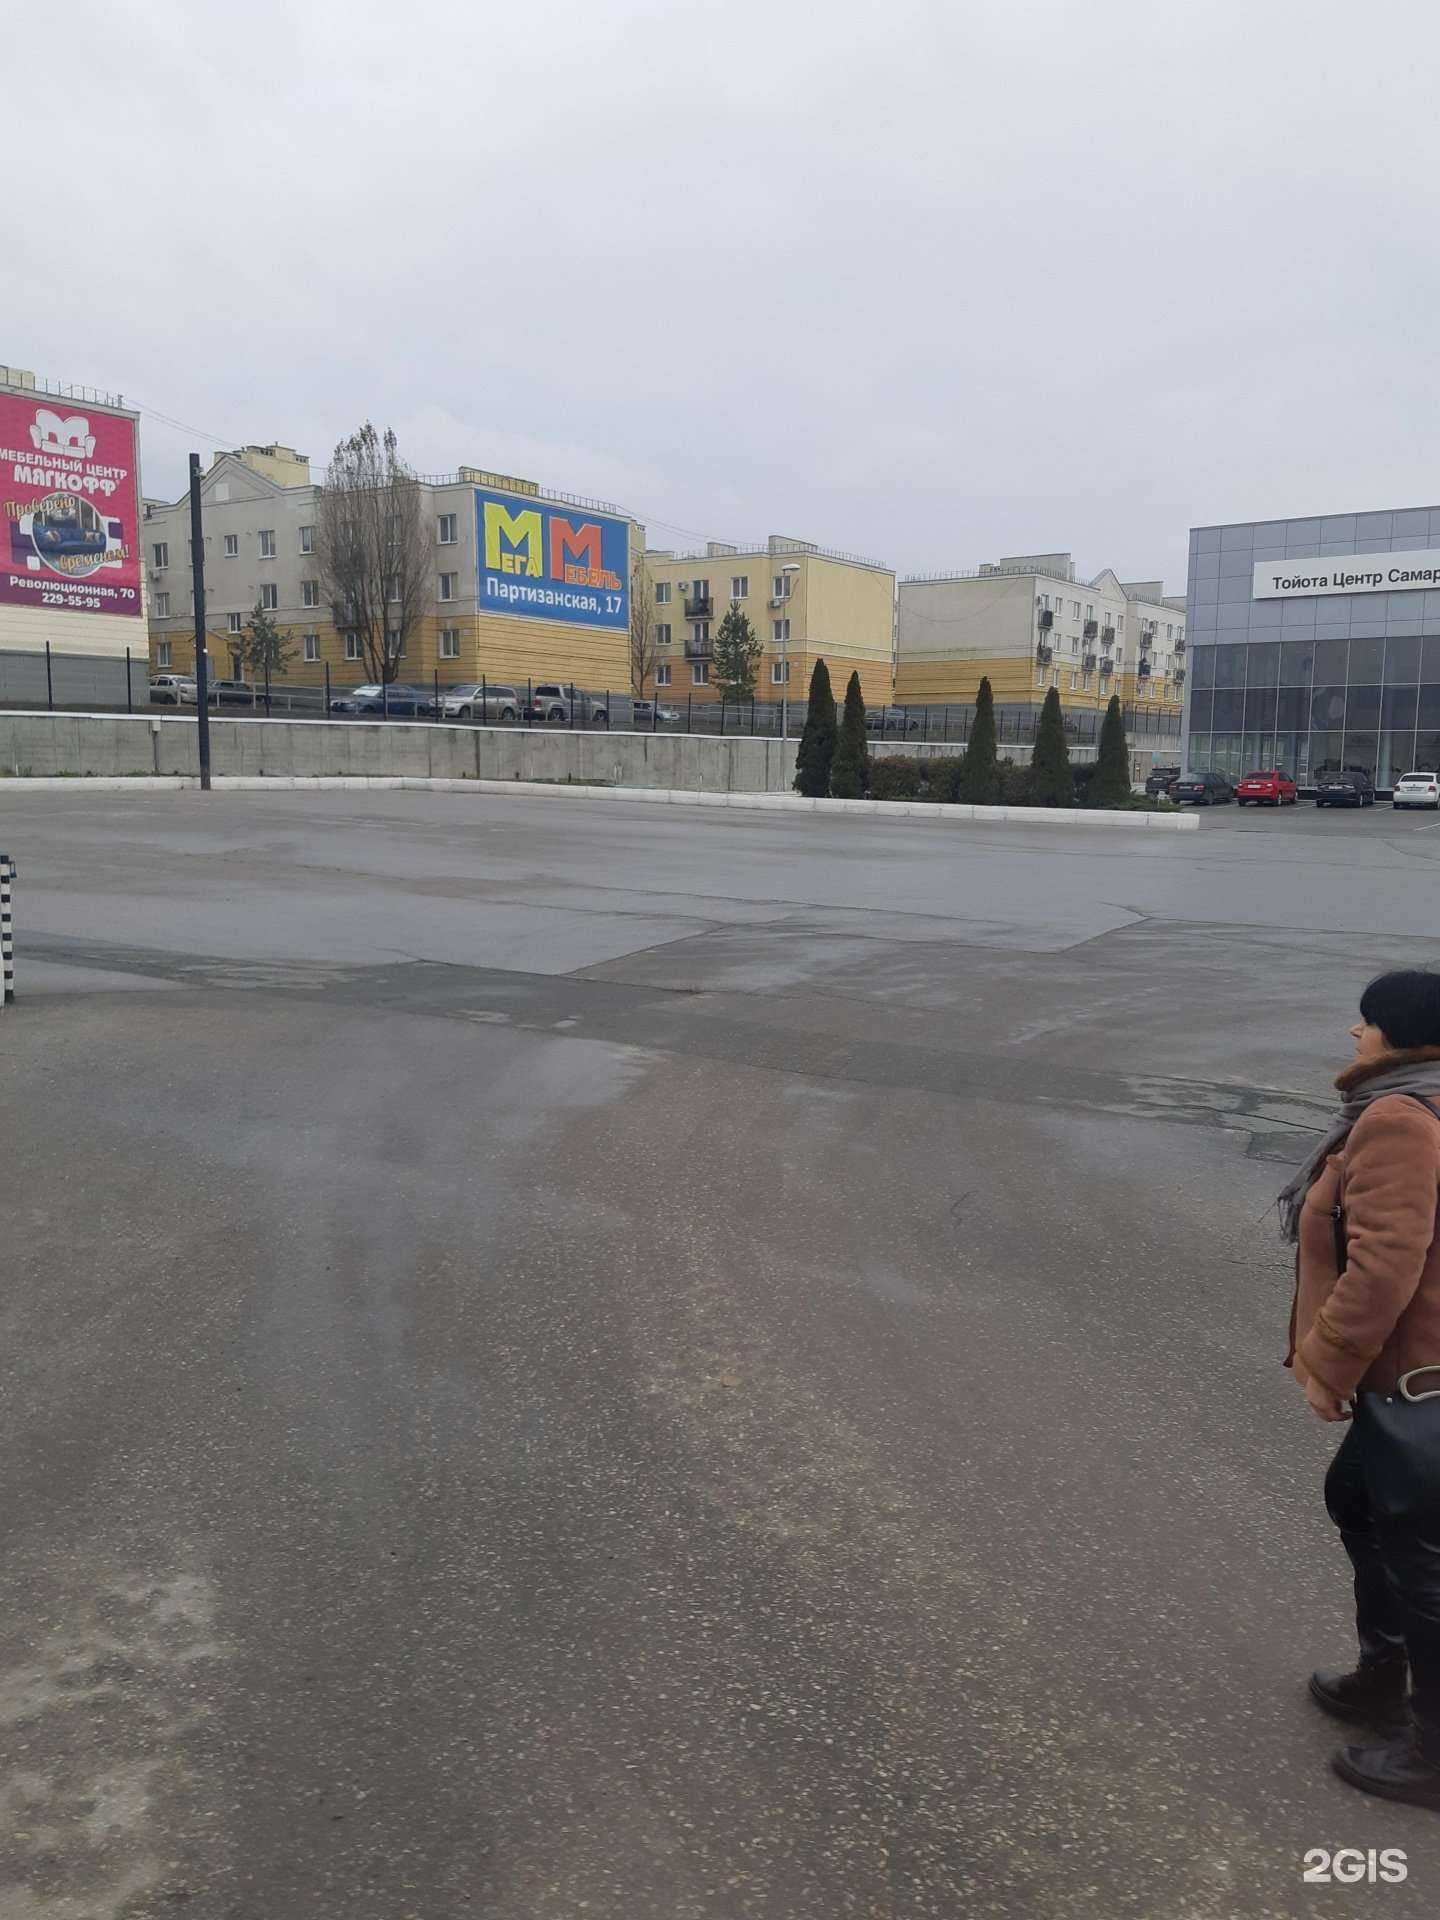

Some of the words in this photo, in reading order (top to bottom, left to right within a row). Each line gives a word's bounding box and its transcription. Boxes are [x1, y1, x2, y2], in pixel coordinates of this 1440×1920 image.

[86, 464, 127, 480] ЦЕНТР
[4, 496, 75, 519] Проверено
[59, 544, 129, 571] временем!
[10, 576, 118, 598] Революционная,
[120, 587, 135, 598] 70
[1272, 576, 1328, 590] Тойота
[1333, 572, 1383, 587] Центр
[42, 592, 101, 608] 229-55-95
[487, 578, 601, 614] Партизанская,
[605, 595, 622, 613] 17
